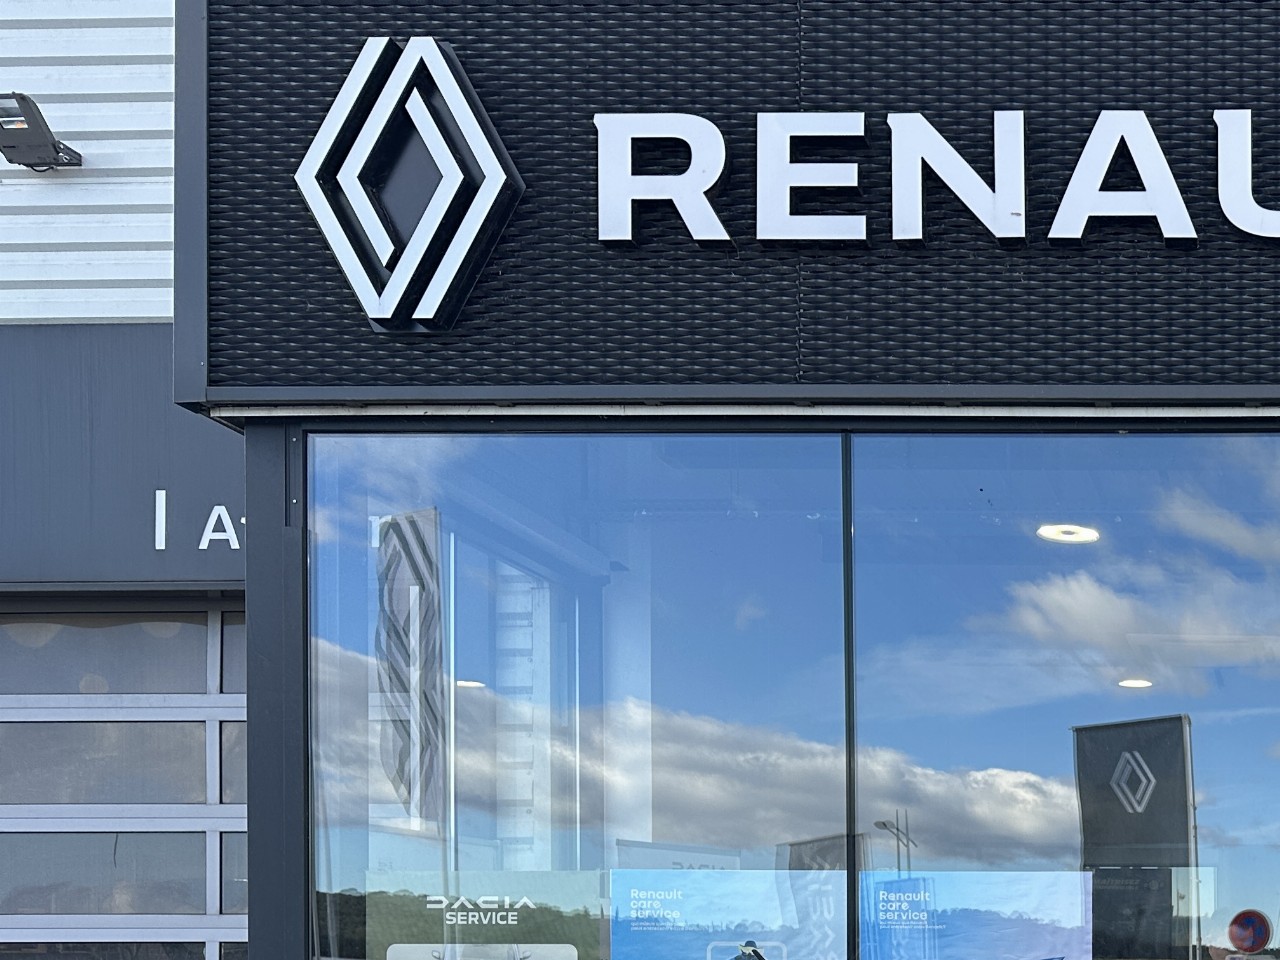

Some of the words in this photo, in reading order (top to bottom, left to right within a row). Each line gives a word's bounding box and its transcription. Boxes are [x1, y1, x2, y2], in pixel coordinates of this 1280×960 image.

[630, 888, 683, 899] Renault
[879, 890, 930, 901] Renault
[427, 896, 537, 908] DACIA
[630, 900, 661, 909] care
[879, 902, 909, 910] care
[445, 912, 518, 925] SERVICE
[630, 909, 681, 918] service
[879, 910, 928, 920] service
